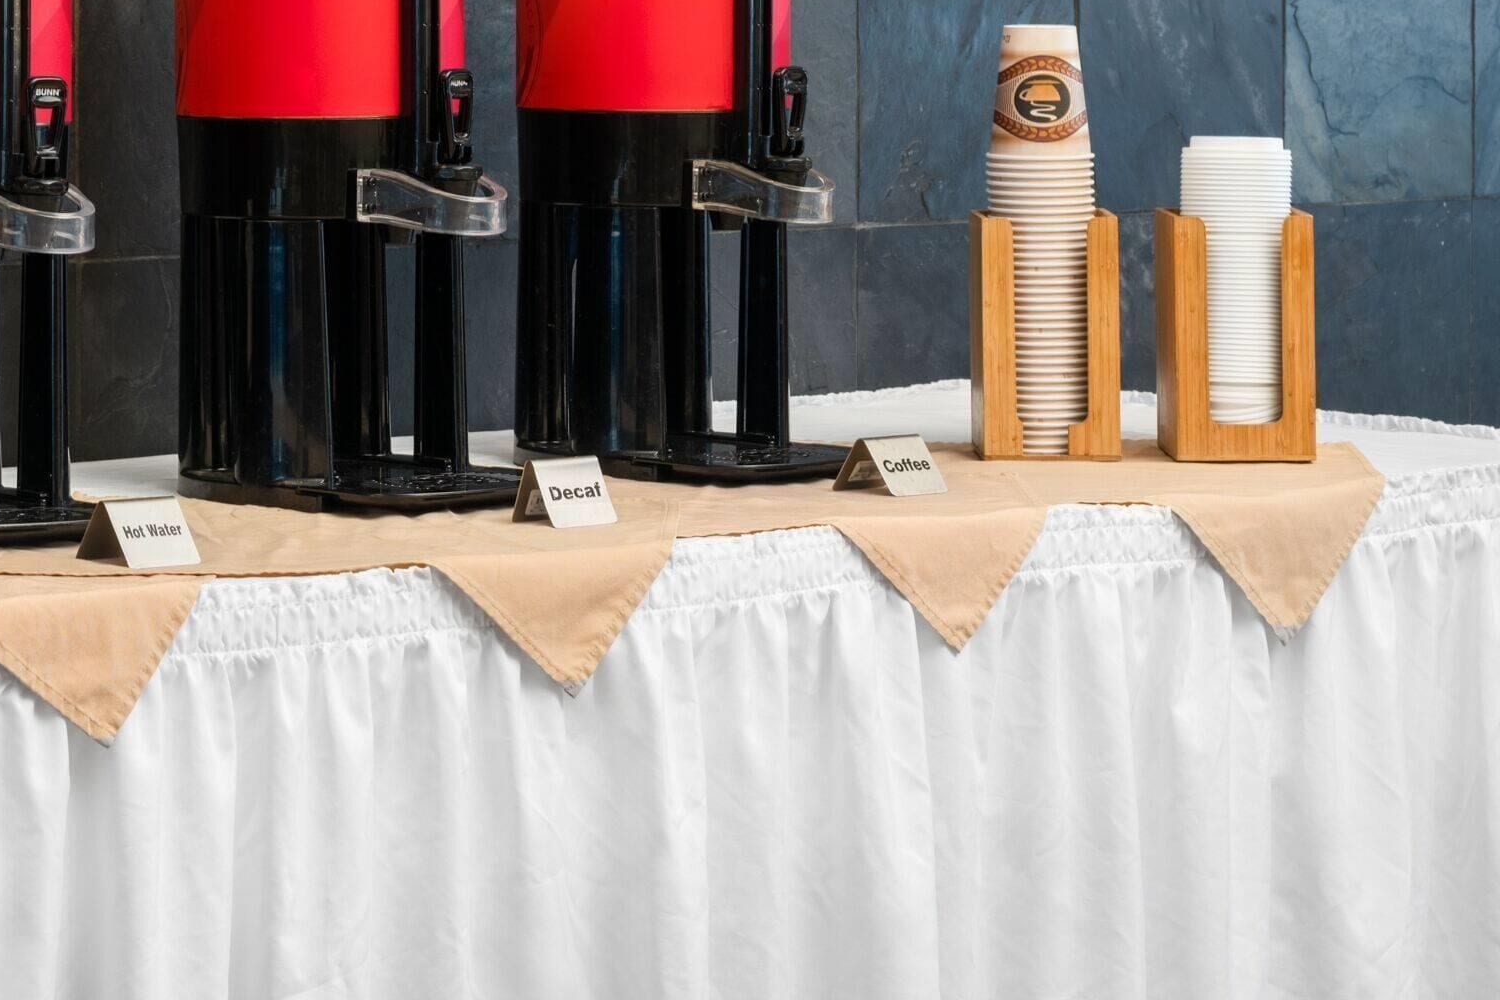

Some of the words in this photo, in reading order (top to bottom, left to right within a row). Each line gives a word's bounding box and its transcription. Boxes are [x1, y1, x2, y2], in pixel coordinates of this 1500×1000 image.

[882, 458, 931, 473] Coffee
[548, 482, 601, 501] Decaf
[122, 525, 146, 539] Hot
[146, 523, 182, 538] Water
